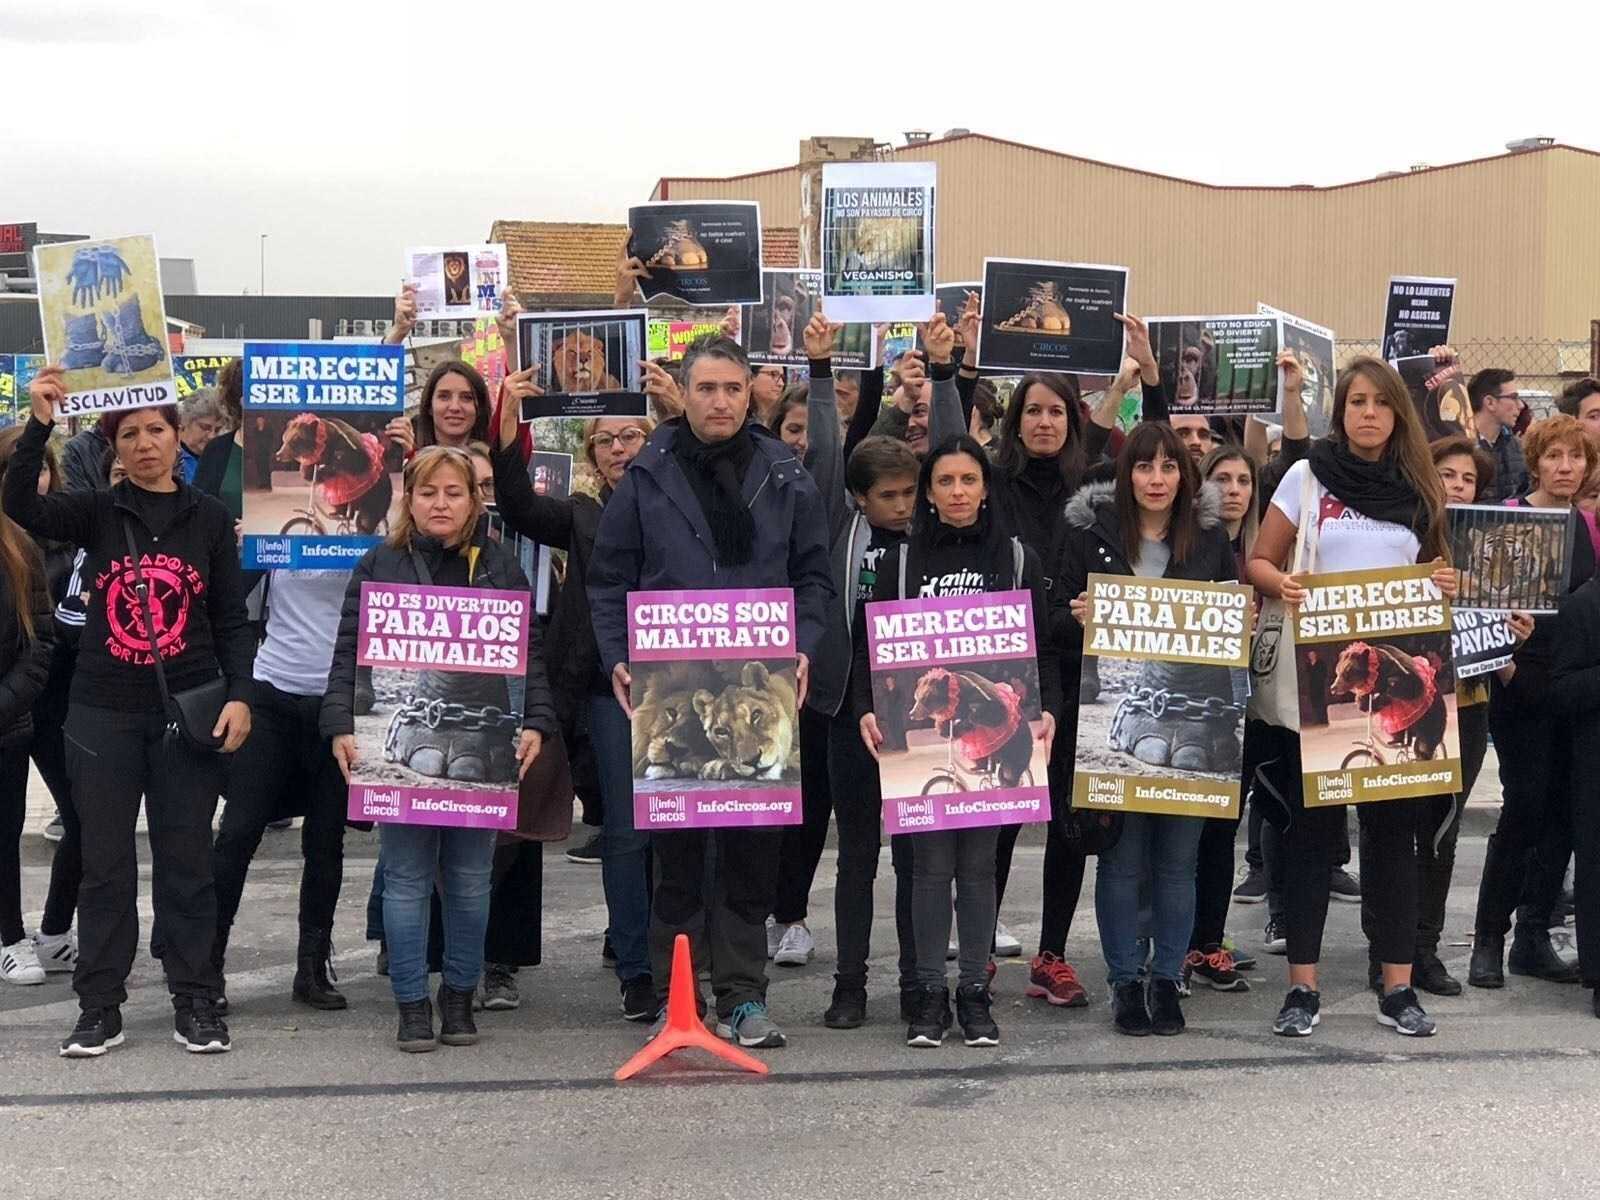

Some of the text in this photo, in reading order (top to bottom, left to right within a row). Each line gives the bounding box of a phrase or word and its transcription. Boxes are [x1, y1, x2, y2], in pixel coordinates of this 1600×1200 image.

[836, 192, 922, 208] LOS ANIMALES
[846, 208, 859, 216] SON
[861, 208, 891, 216] PAYASOS
[902, 208, 922, 216] CIRCO
[844, 271, 914, 280] VEGANISMO
[1393, 286, 1404, 295] NO
[1406, 286, 1414, 296] LO
[1399, 310, 1440, 320] NO ASISTAS
[250, 356, 399, 381] MERECEN
[250, 384, 398, 405] SER LIBRES
[265, 540, 282, 550] info
[256, 554, 291, 564] CIRCOS
[940, 568, 984, 587] anim
[1094, 583, 1246, 608] NO ES DIVERTIDO
[1299, 577, 1442, 612] MERECEN
[368, 592, 524, 615] NO ES DIVERTIDO
[634, 602, 788, 625] CIRCOS SON
[874, 604, 1026, 640] MERECEN
[1093, 600, 1244, 634] PARA LOS
[1300, 605, 1444, 638] SER LIBRES
[1453, 610, 1511, 631] NO SO
[366, 608, 521, 642] PARA LOS
[635, 626, 790, 650] MALTRATO
[1090, 628, 1242, 660] ANIMALES
[105, 636, 186, 664] POR LA PAZ
[364, 638, 518, 668] ANIMALES
[876, 632, 1028, 664] SER LIBRES
[1097, 780, 1115, 790] info
[1326, 776, 1344, 788] info
[1362, 771, 1452, 788] InfoCircos.org
[374, 792, 392, 802] info
[1088, 793, 1124, 804] CIRCOS
[1135, 786, 1230, 807] InfoCircos.org
[1319, 788, 1353, 800] CIRCOS
[364, 806, 400, 816] CIRCOS
[412, 798, 508, 817] InfoCircos.org
[658, 798, 676, 808] info
[697, 800, 792, 814] InfoCircos.org
[906, 802, 925, 814] info
[944, 799, 1040, 815] InfoCircos.org
[650, 812, 686, 822] CIRCOS
[900, 815, 935, 827] CIRCOS
